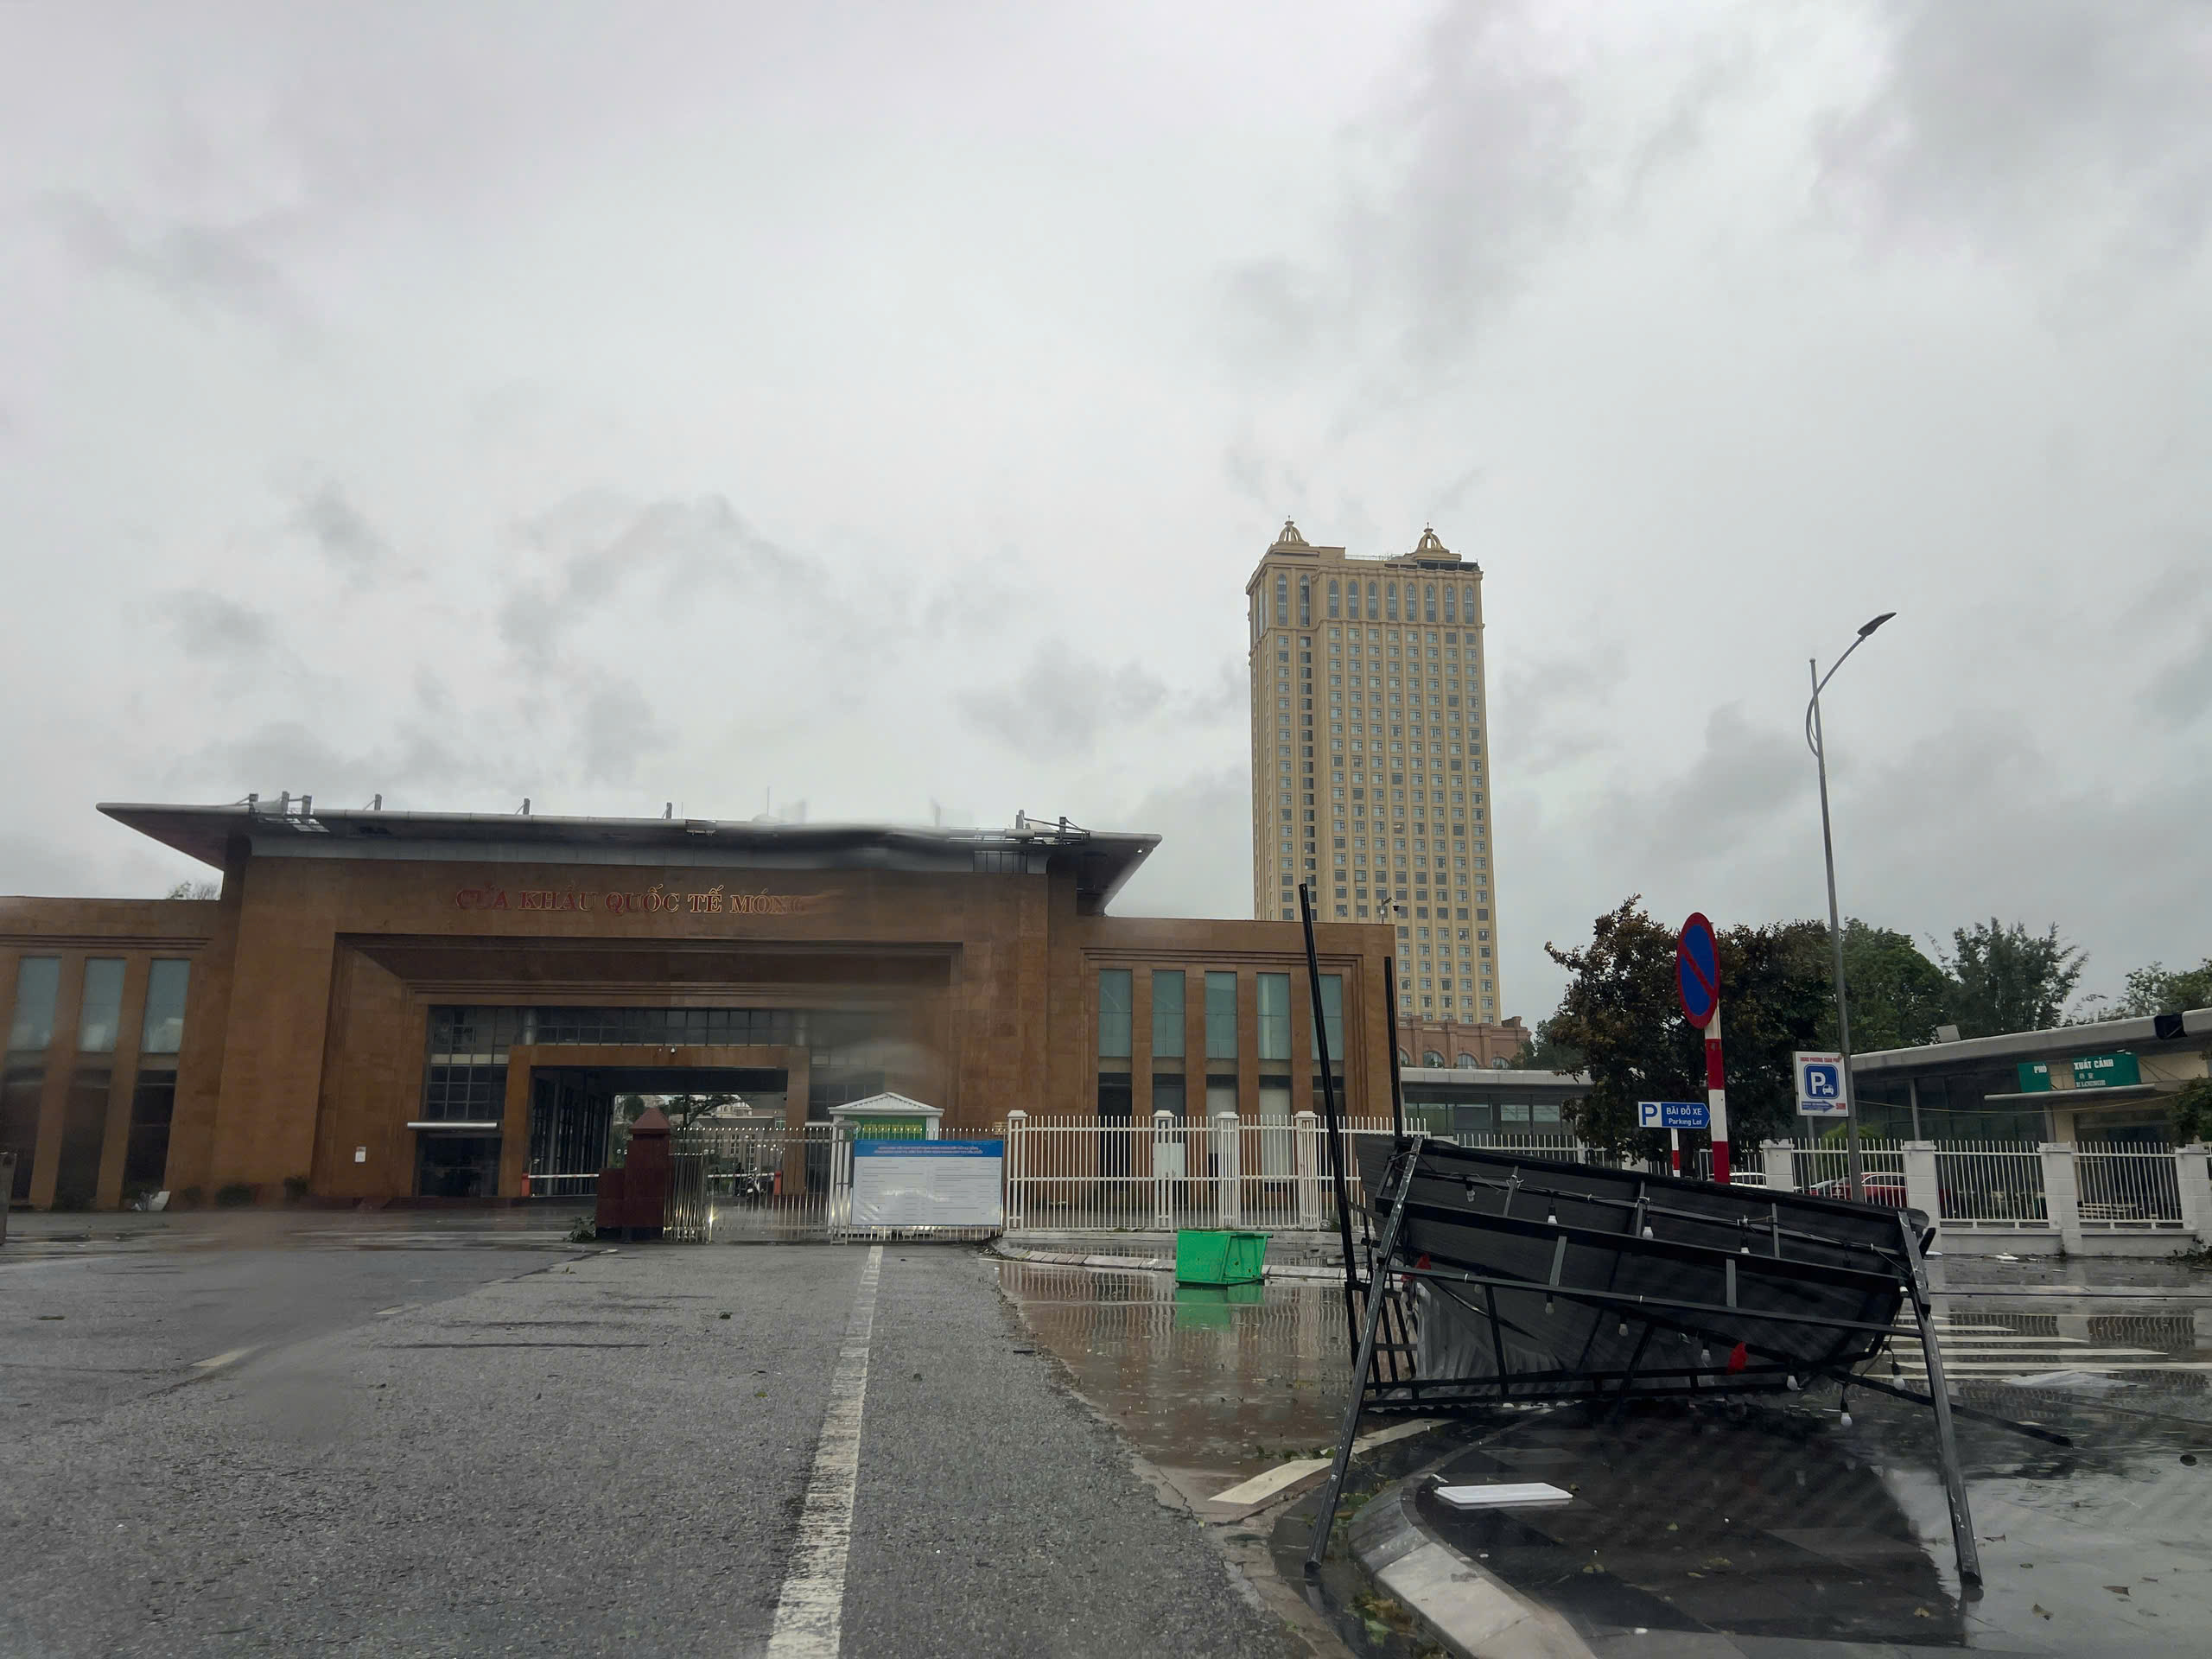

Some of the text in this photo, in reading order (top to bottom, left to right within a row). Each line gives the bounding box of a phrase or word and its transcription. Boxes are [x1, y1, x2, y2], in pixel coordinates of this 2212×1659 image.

[605, 883, 680, 916] QUỐC
[688, 884, 724, 913] TẾ
[1810, 1071, 1826, 1095] P
[1641, 1103, 1658, 1126] P
[1668, 1117, 1692, 1126] Parking
